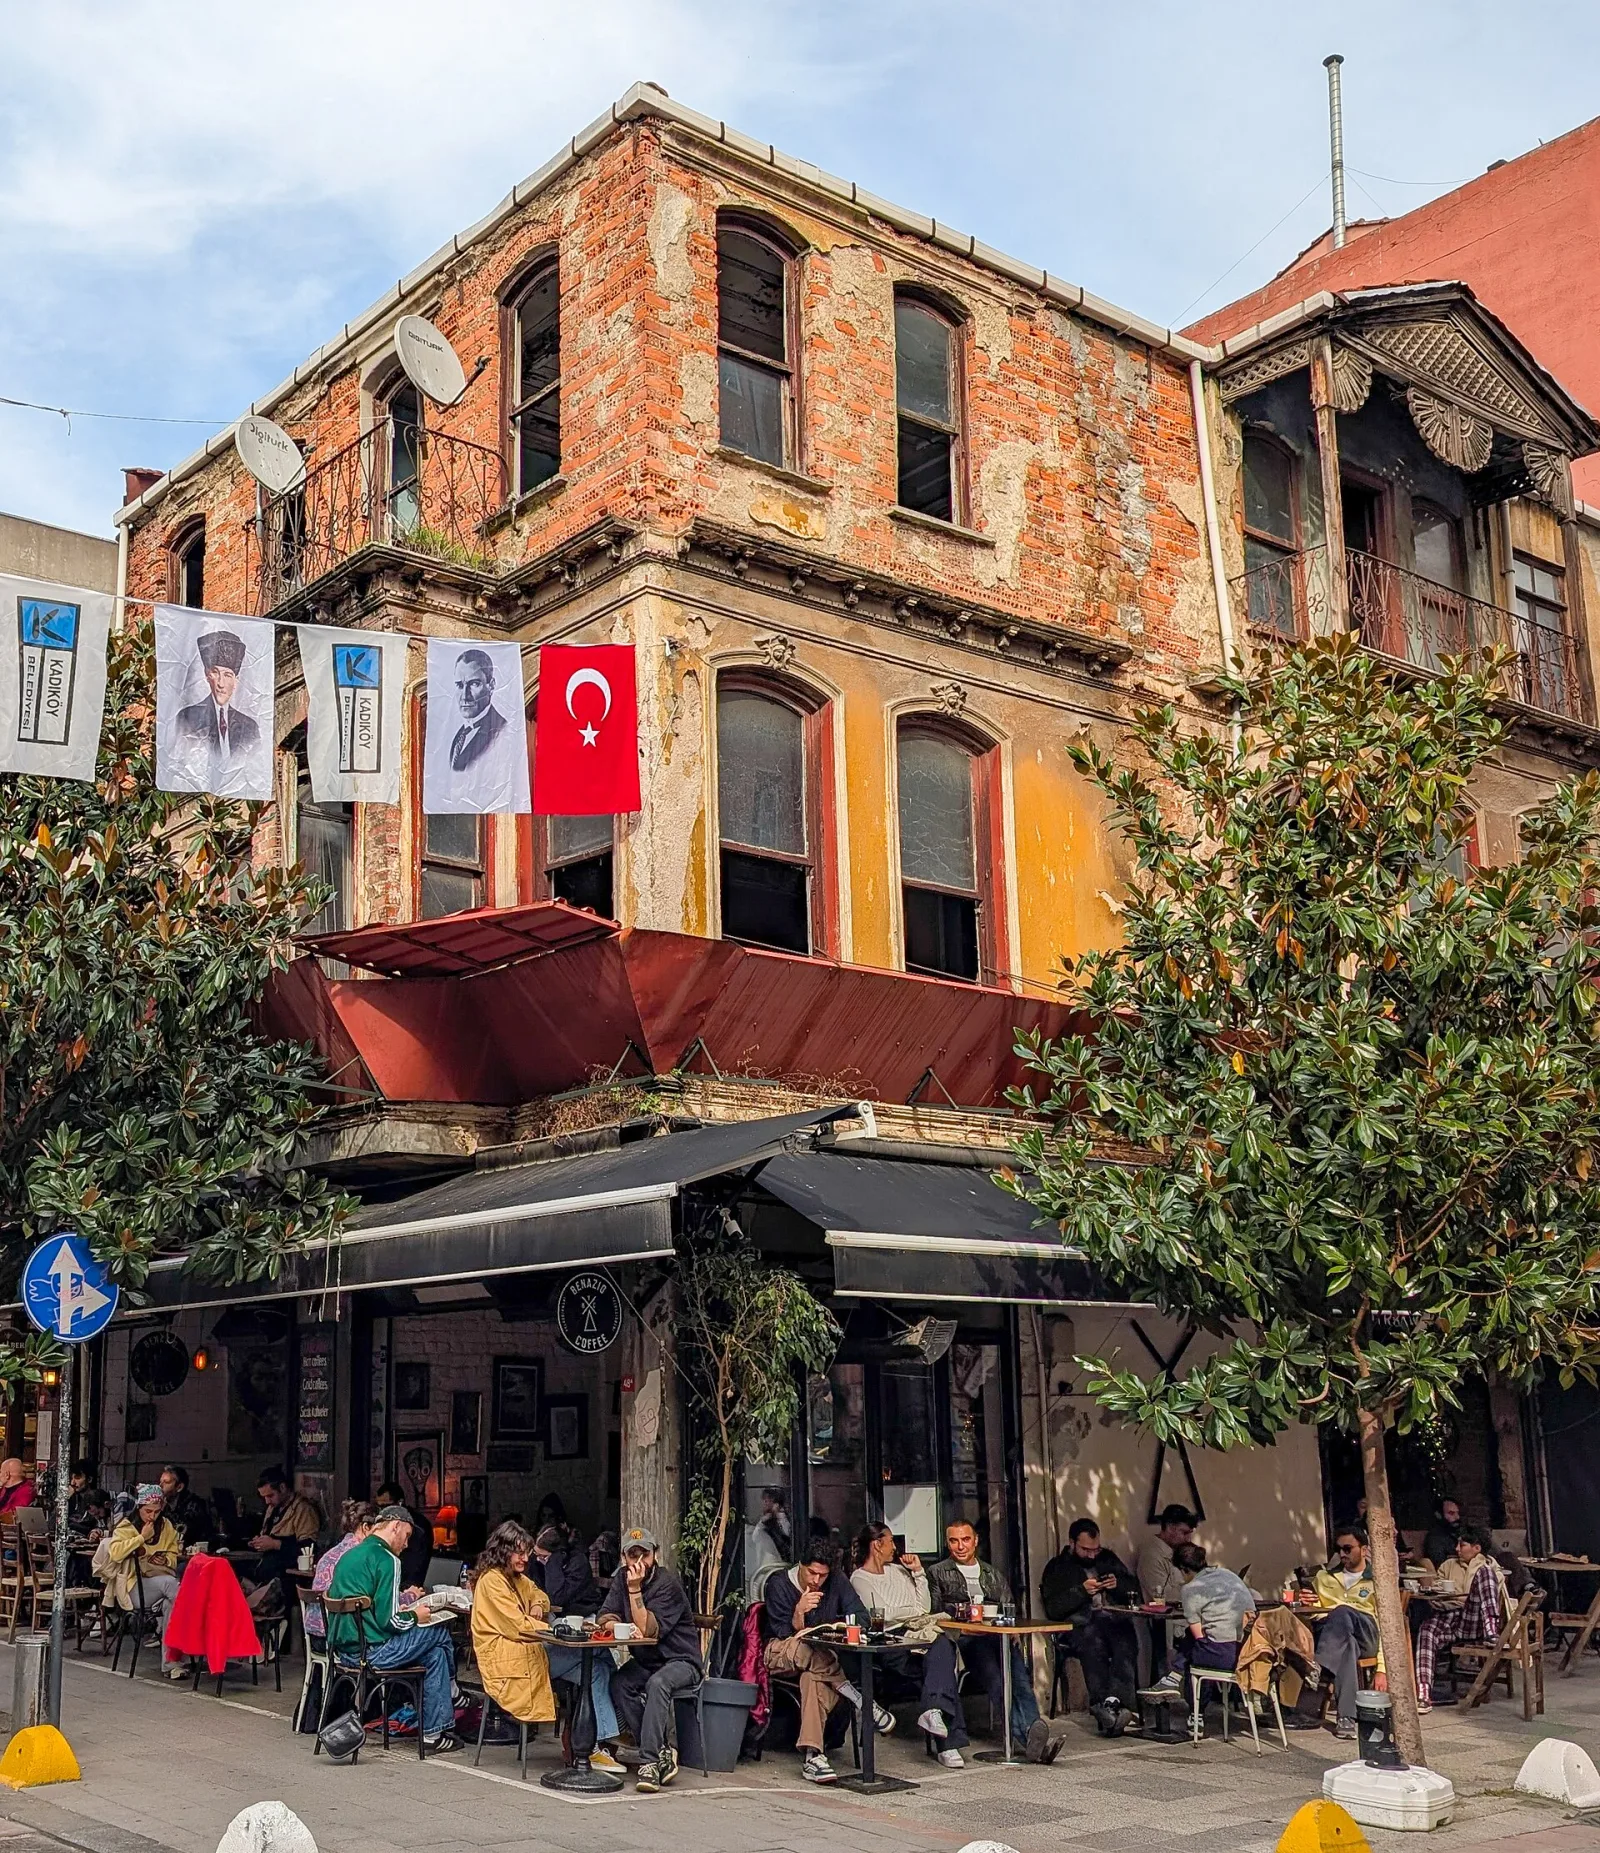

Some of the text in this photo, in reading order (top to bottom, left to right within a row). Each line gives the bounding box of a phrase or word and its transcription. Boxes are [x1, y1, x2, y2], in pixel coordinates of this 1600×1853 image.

[22, 655, 36, 730] BELEDİYESİ
[45, 658, 64, 718] KADIKÖY
[359, 697, 374, 749] KADIKÖY
[569, 1277, 607, 1295] BENAZIO
[574, 1333, 609, 1350] COFFEE
